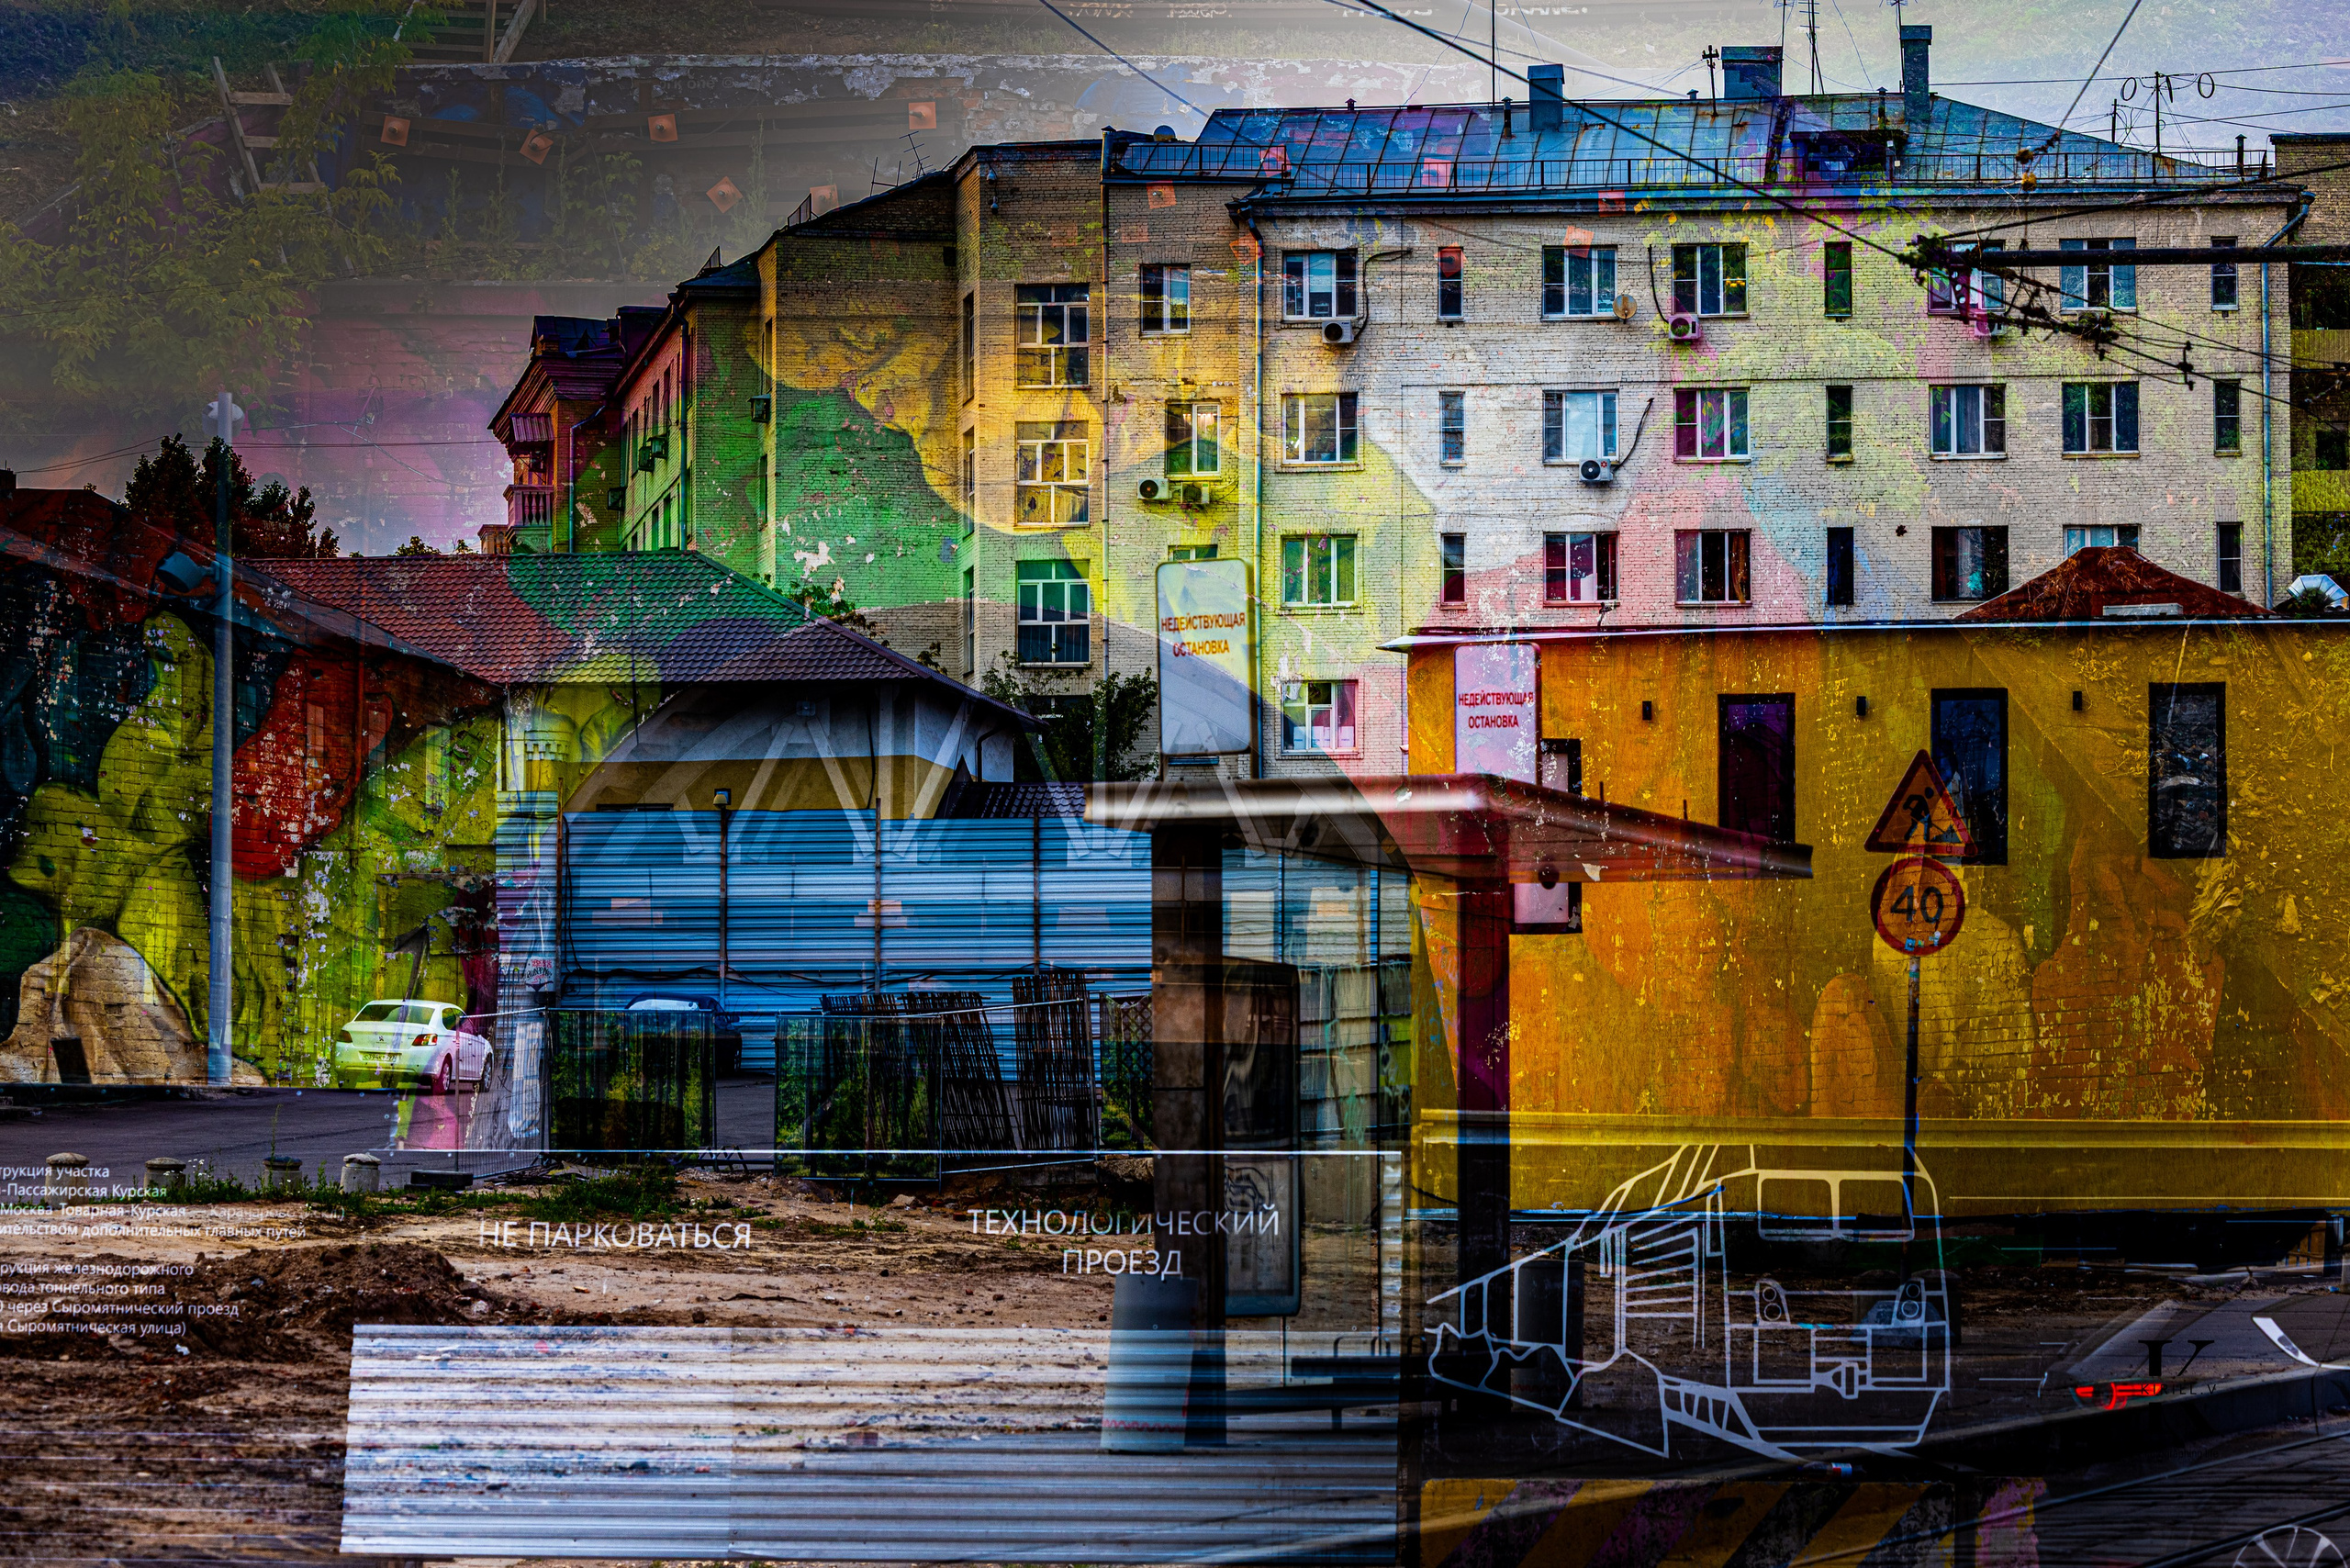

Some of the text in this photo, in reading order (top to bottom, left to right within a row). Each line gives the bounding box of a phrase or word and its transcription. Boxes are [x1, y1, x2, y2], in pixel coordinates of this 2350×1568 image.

[1160, 612, 1246, 633] НЕДЕЙСТВУЮЩАЯ
[1172, 640, 1230, 657] ОСТАНОВКА
[1458, 690, 1534, 708] НЕДЕЙСТВУЮЩАЯ
[1469, 715, 1519, 729] ОСТАНОВКА
[1890, 885, 1943, 924] 40
[56, 1167, 110, 1181] участка
[112, 1184, 167, 1201] Курская
[0, 1203, 52, 1215] Москва
[967, 1204, 1279, 1237] ТЕХНОЛОГИЧЕСКИЙ
[82, 1226, 200, 1238] дополнительных
[205, 1226, 262, 1238] главных
[266, 1222, 307, 1241] путей
[479, 1221, 750, 1249] НЕ ПАРКОВАТЬСЯ
[53, 1264, 194, 1279] железнодорожного
[1063, 1249, 1183, 1280] ПРОЕЗД
[39, 1283, 129, 1295] тоннельного
[134, 1284, 165, 1295] типа
[7, 1302, 48, 1316] через
[52, 1300, 183, 1316] Сыромятнический
[188, 1303, 239, 1317] проезд
[7, 1318, 136, 1336] Сыромятническая
[140, 1321, 186, 1338] улица)
